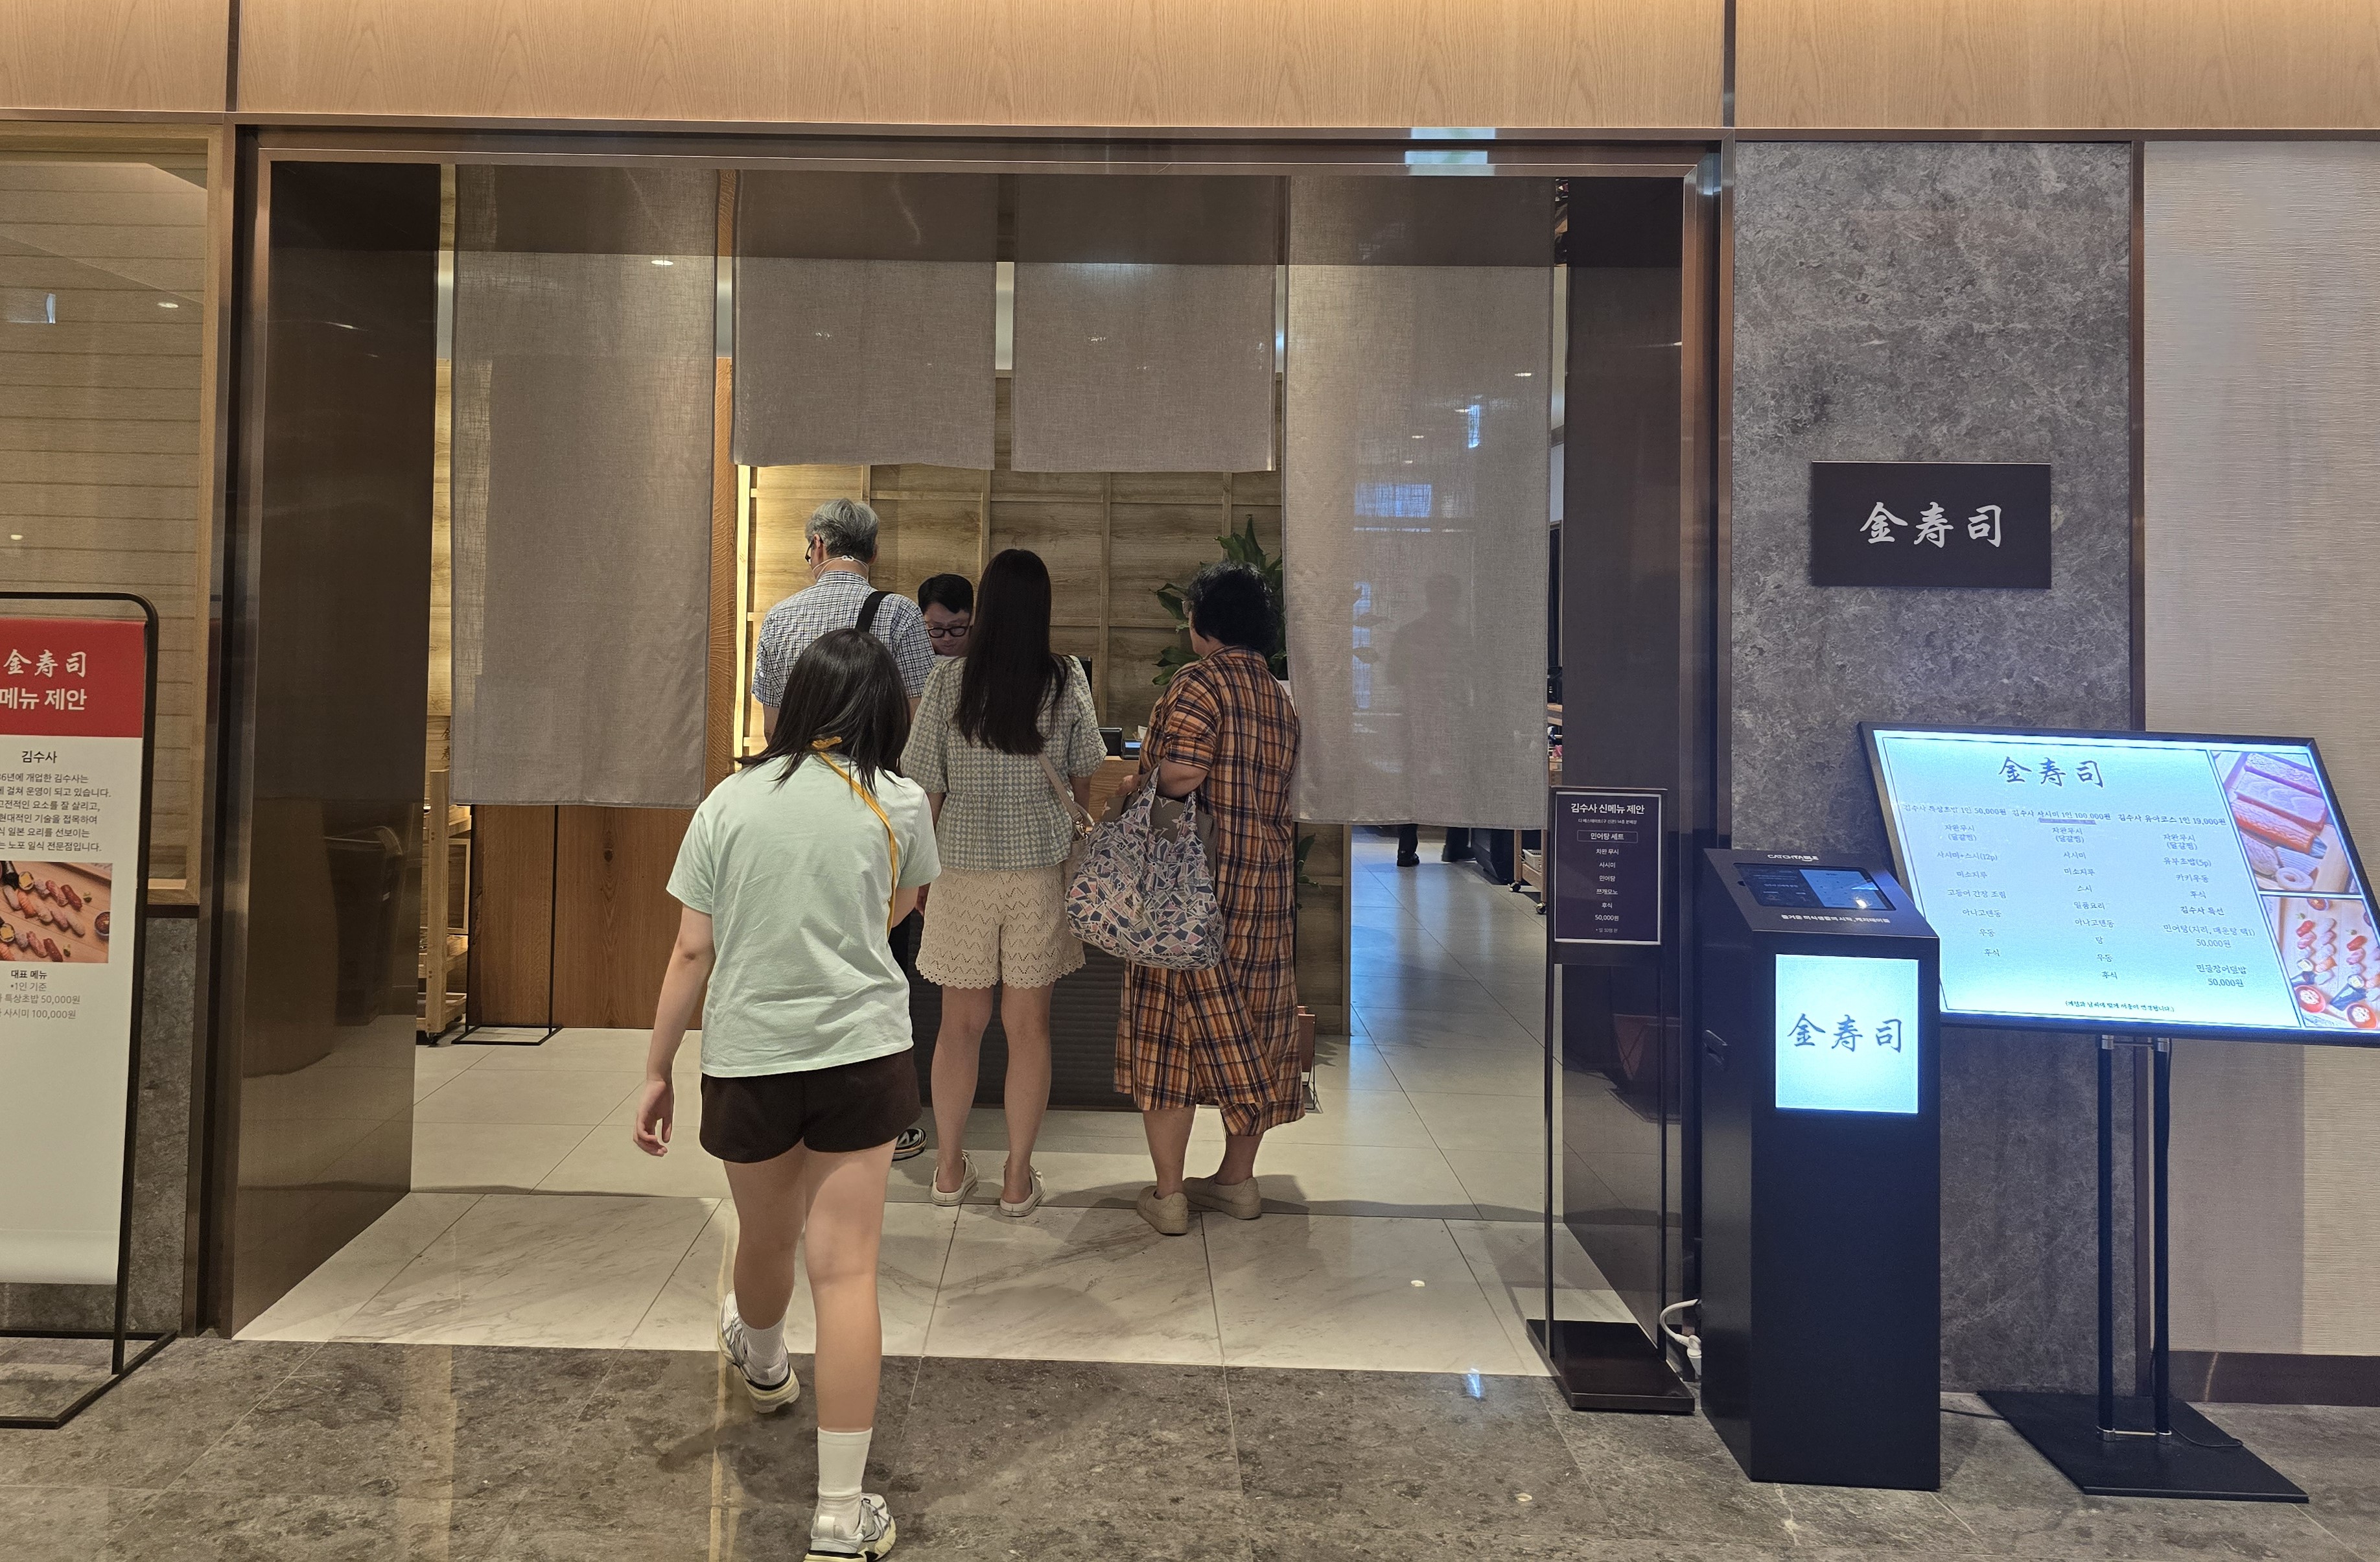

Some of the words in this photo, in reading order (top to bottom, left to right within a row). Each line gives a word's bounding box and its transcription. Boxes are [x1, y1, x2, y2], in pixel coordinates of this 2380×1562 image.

[1860, 502, 2001, 548] 金寿司
[3, 649, 87, 677] 金寿司
[0, 687, 40, 709] 메뉴
[44, 688, 88, 710] 제안
[21, 751, 57, 764] 김수사
[1998, 756, 2103, 788] 金寿司
[26, 773, 52, 783] 개업한
[54, 774, 89, 784] 김수사는
[6, 786, 23, 796] 걸쳐
[26, 787, 51, 796] 운영이
[54, 787, 72, 797] 되고
[74, 787, 111, 797] 있습니다.
[32, 800, 58, 810] 요소를
[61, 801, 69, 810] 잘
[72, 801, 100, 812] 살리고,
[1571, 803, 1597, 813] 김수사
[1599, 804, 1625, 813] 신메뉴
[1626, 804, 1644, 814] 제안
[0, 813, 32, 823] 현대적인
[34, 814, 60, 824] 기술을
[63, 815, 97, 824] 접목하여
[2193, 817, 2226, 826] 19,000원
[8, 827, 24, 837] 일본
[27, 828, 52, 837] 요리를
[55, 828, 90, 838] 선보이는
[2164, 833, 2196, 842] 자완무시
[28, 841, 44, 850] 일식
[47, 842, 102, 852] 전문점입니다.
[1937, 851, 1998, 861] 사시미+스시(12p)
[2163, 857, 2212, 868] 유부초밥(5p)
[2176, 874, 2209, 883] 카키우동
[1991, 891, 2007, 899] 조림
[2190, 891, 2206, 899] 후식
[2073, 902, 2105, 910] 일품요리
[2180, 905, 2205, 915] 김수사
[2208, 907, 2225, 916] 특선
[1979, 928, 1995, 937] 우동
[2213, 926, 2237, 935] 매운탕
[2095, 936, 2103, 944] 탕
[2196, 939, 2232, 948] 50,000원
[1984, 948, 2000, 957] 후식
[2097, 953, 2113, 962] 우동
[2196, 964, 2247, 974] 민물장어덮밥
[11, 970, 28, 979] 대표
[30, 970, 47, 979] 메뉴
[2102, 971, 2118, 979] 후식
[29, 983, 47, 992] 기준
[2208, 978, 2245, 987] 50,000원
[5, 994, 39, 1003] 특상초밥
[41, 995, 80, 1005] 50,000원
[4, 1008, 29, 1018] 사시미
[32, 1010, 76, 1020] 100,000원
[1787, 1013, 1902, 1053] 金寿司
